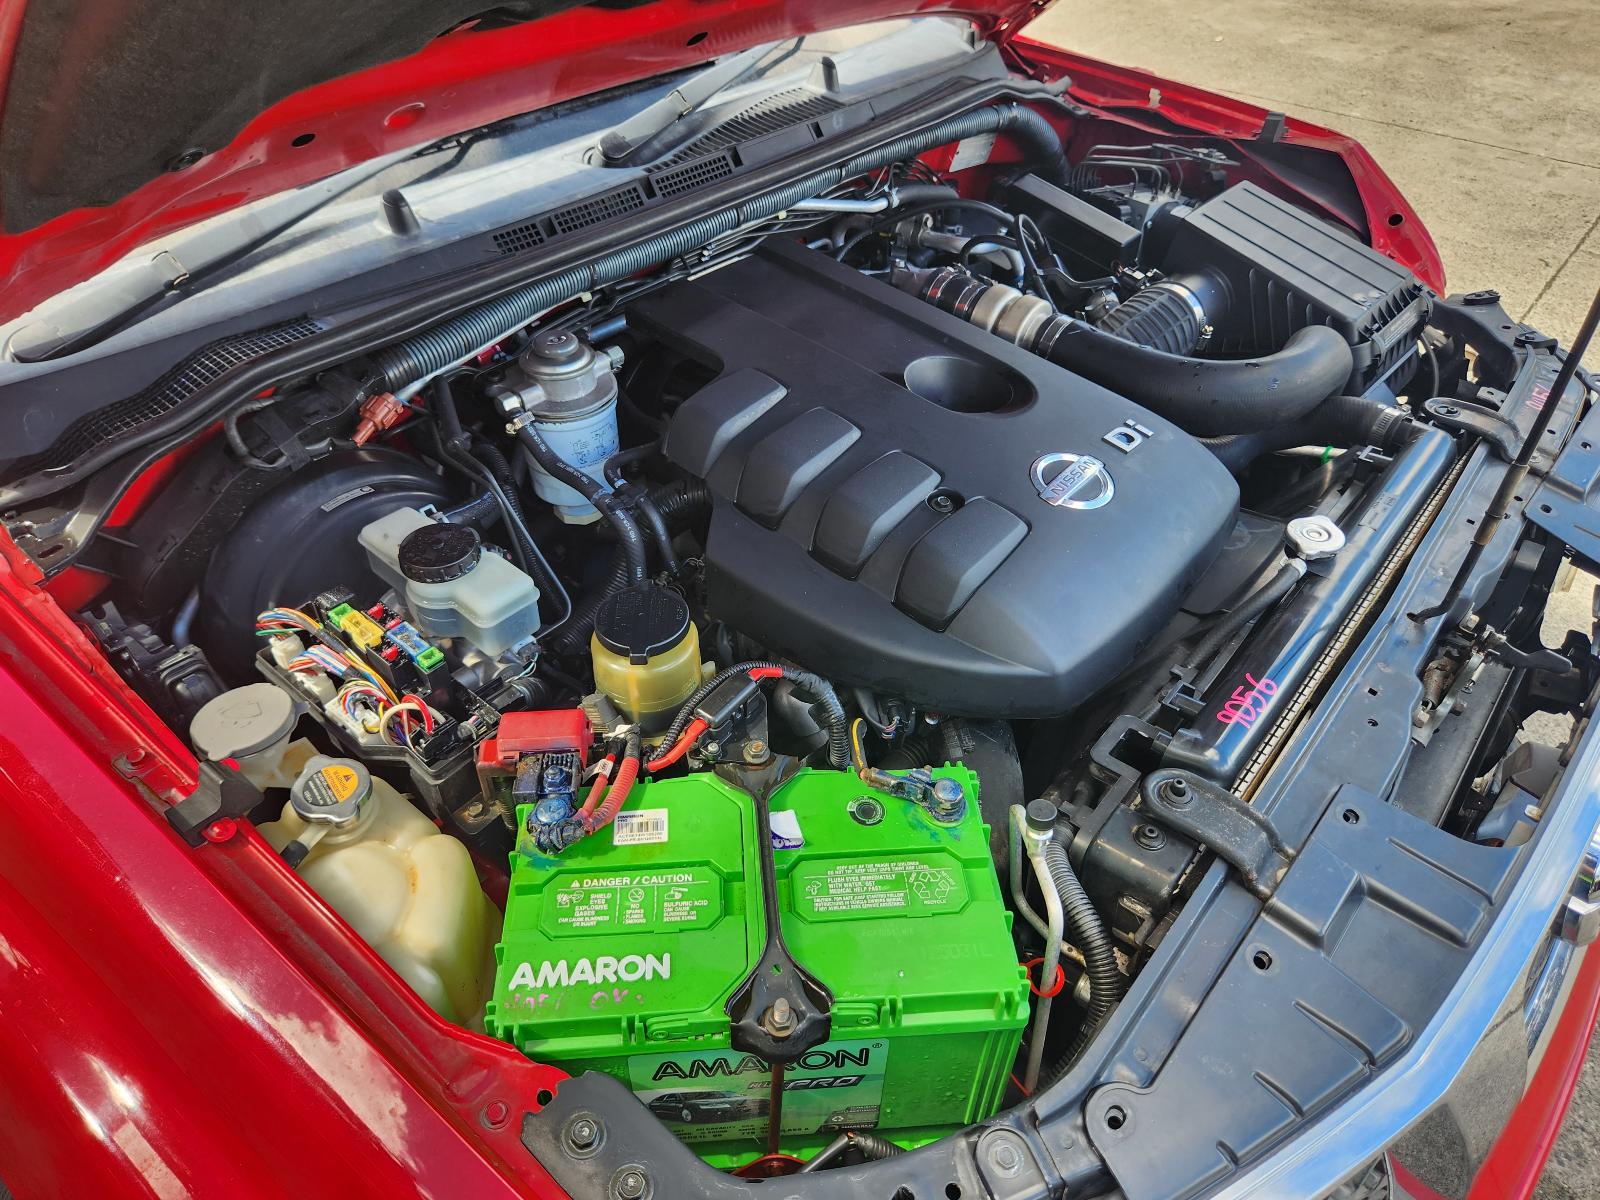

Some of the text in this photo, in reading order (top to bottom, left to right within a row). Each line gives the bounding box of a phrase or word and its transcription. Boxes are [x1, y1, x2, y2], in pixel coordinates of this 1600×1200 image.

[1050, 458, 1097, 496] NISSAN
[583, 877, 630, 887] DANGER
[642, 874, 692, 884] CAUTION
[508, 953, 670, 990] AMARON
[652, 1048, 869, 1081] AMAON
[785, 1076, 859, 1090] PRO
